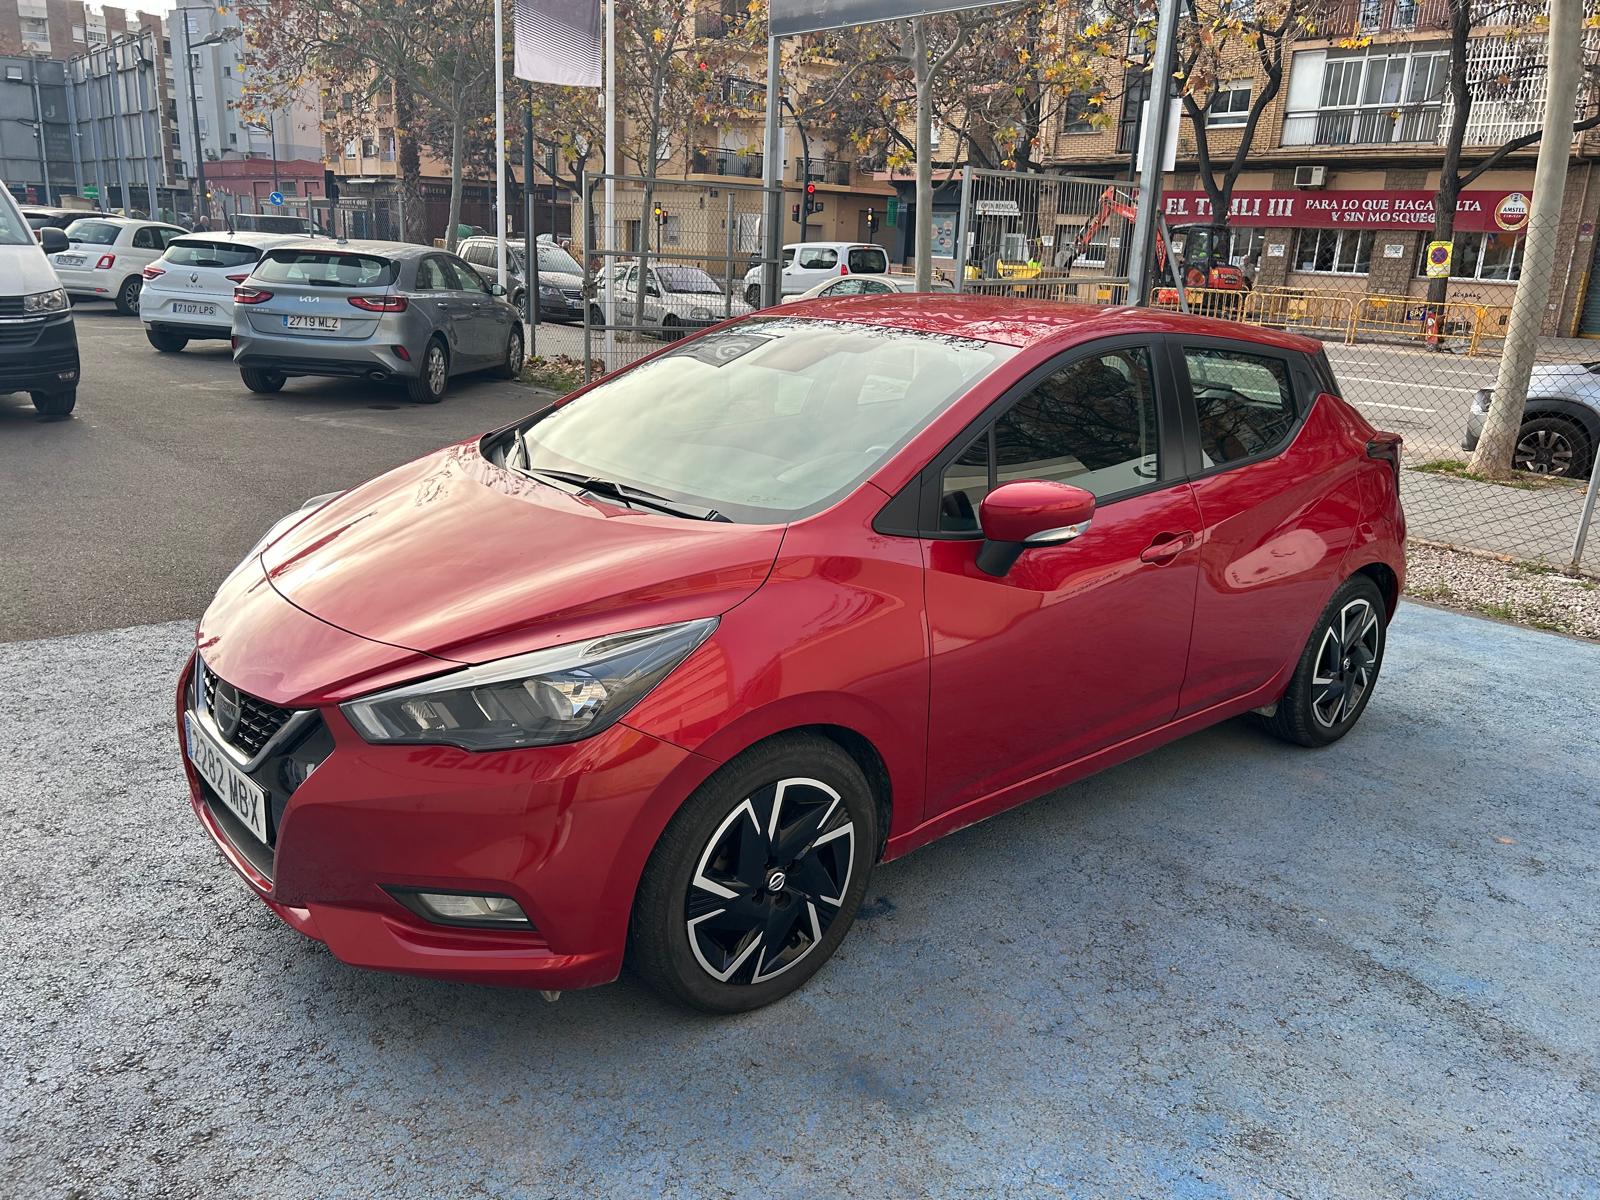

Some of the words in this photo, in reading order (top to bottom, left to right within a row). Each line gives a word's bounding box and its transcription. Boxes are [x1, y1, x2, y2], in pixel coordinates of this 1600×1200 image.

[1165, 198, 1188, 215] EL
[1305, 199, 1338, 210] PARA
[1341, 199, 1359, 210] LO
[1362, 199, 1390, 211] QUE
[1394, 199, 1434, 211] HAGA
[1331, 211, 1341, 222] Y
[1343, 212, 1366, 222] SIN
[177, 304, 197, 313] 7107
[200, 305, 214, 315] LPS
[289, 315, 315, 327] 2719
[318, 317, 338, 329] MLZ
[192, 728, 225, 796] 2282
[228, 767, 260, 832] MBX
